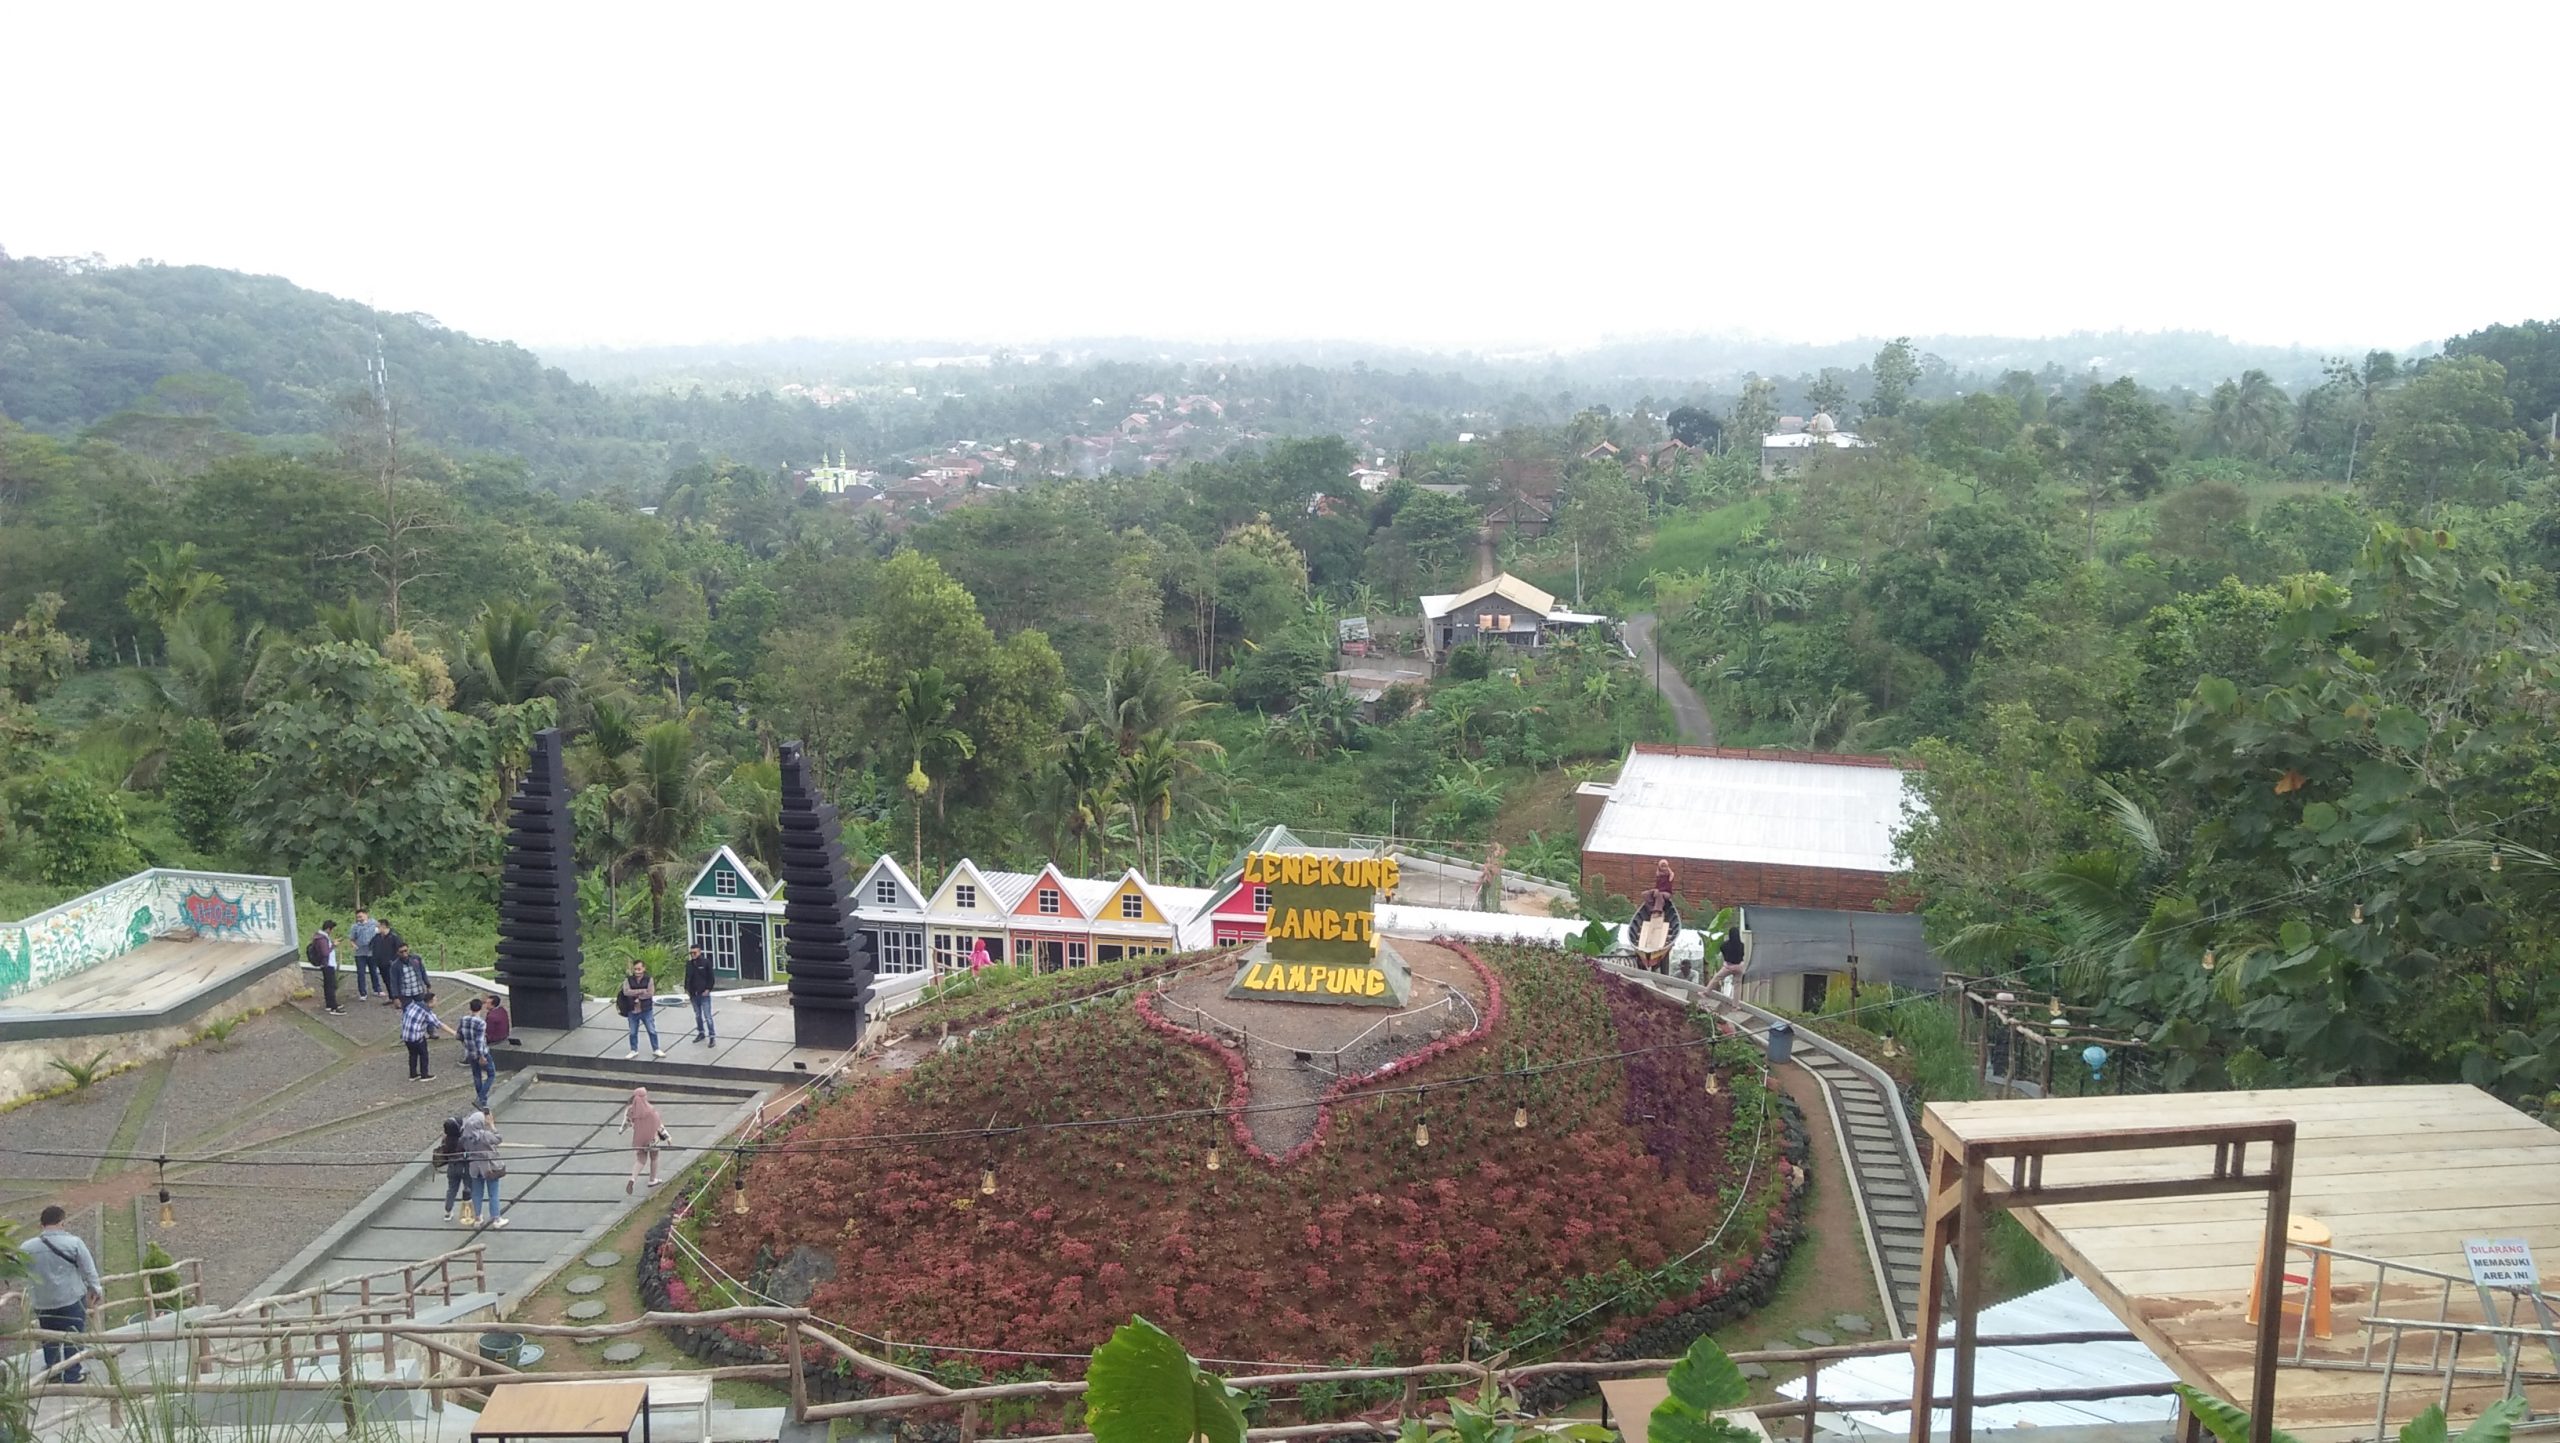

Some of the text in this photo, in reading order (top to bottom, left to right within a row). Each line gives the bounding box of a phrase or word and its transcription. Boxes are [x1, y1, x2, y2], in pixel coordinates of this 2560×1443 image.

[1243, 851, 1399, 888] LENGKUNG
[1264, 907, 1376, 941] LANGIT
[1243, 964, 1385, 996] LAMPUNG
[2471, 1246, 2524, 1254] DILARANG
[2473, 1258, 2530, 1267] MEMASUKI
[2483, 1271, 2529, 1280] AREA INI
